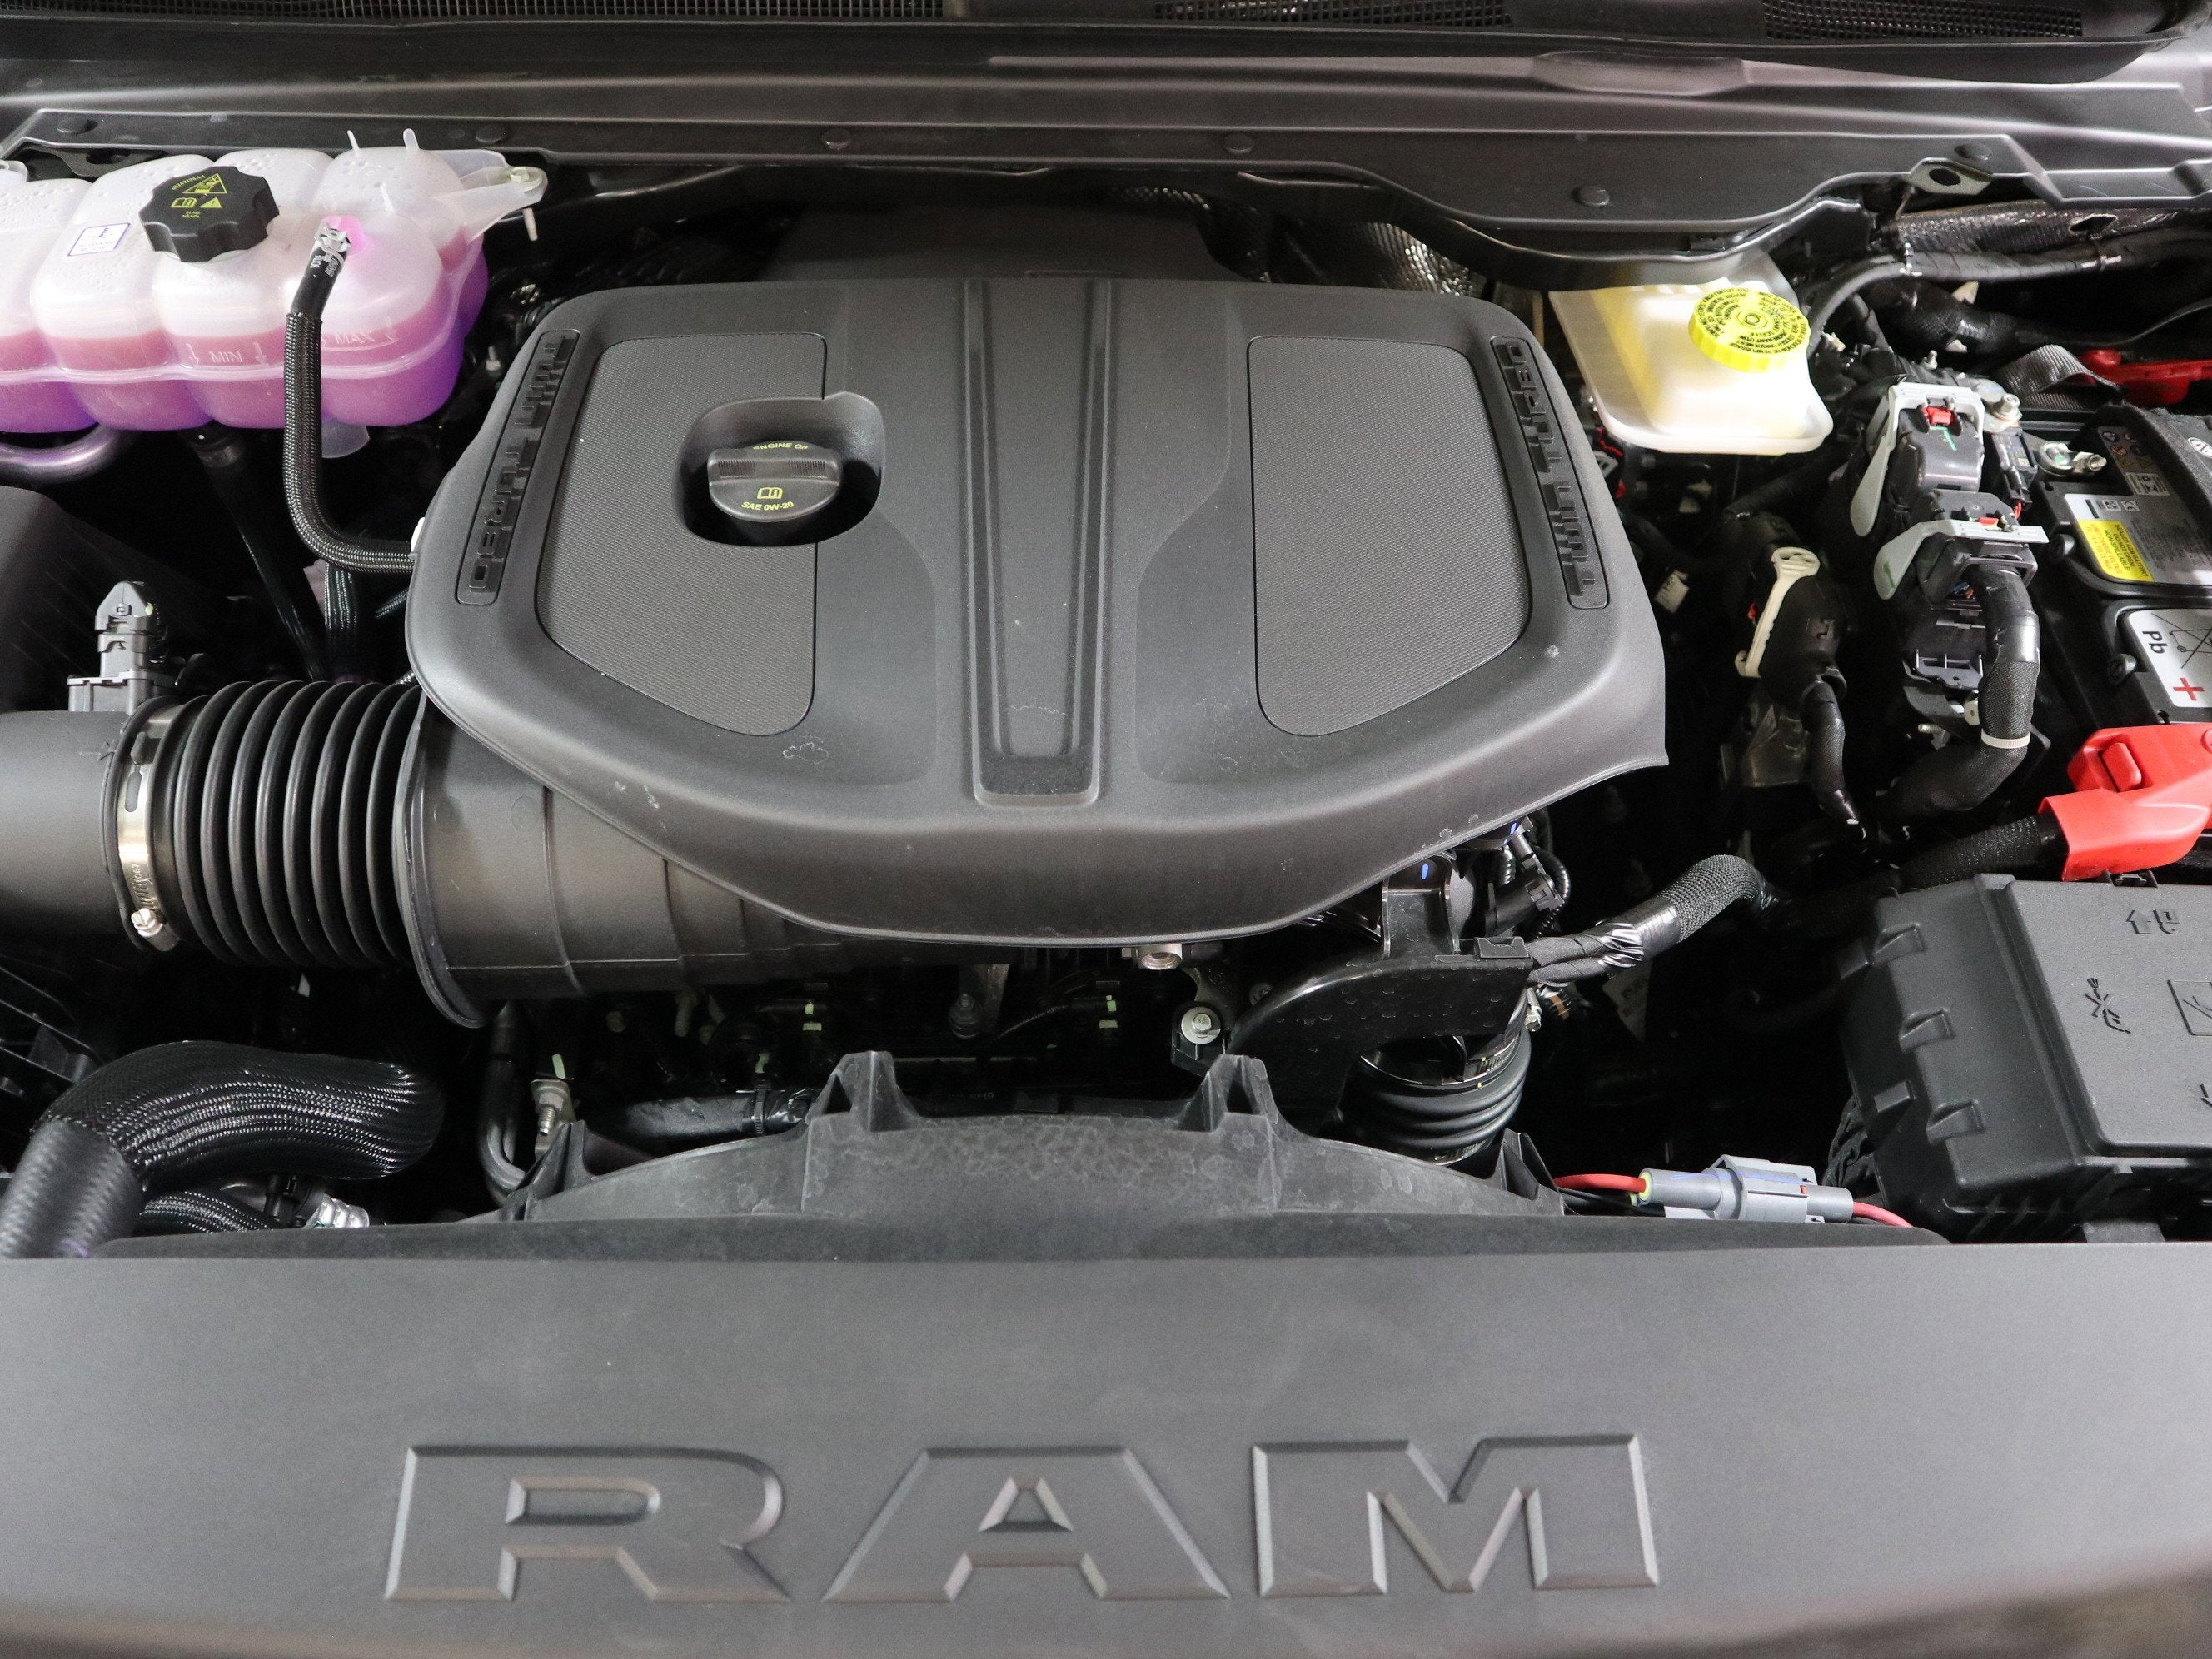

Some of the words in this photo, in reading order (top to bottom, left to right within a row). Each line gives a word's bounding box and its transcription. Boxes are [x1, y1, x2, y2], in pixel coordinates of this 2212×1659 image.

[335, 332, 375, 344] MAX
[208, 351, 242, 363] MIN
[1496, 343, 1563, 473] TURBO
[469, 437, 539, 593] TURBO
[741, 501, 761, 510] SAE
[764, 501, 794, 511] 0W-20
[2142, 630, 2168, 654] Pb
[384, 1433, 1661, 1604] RAM
